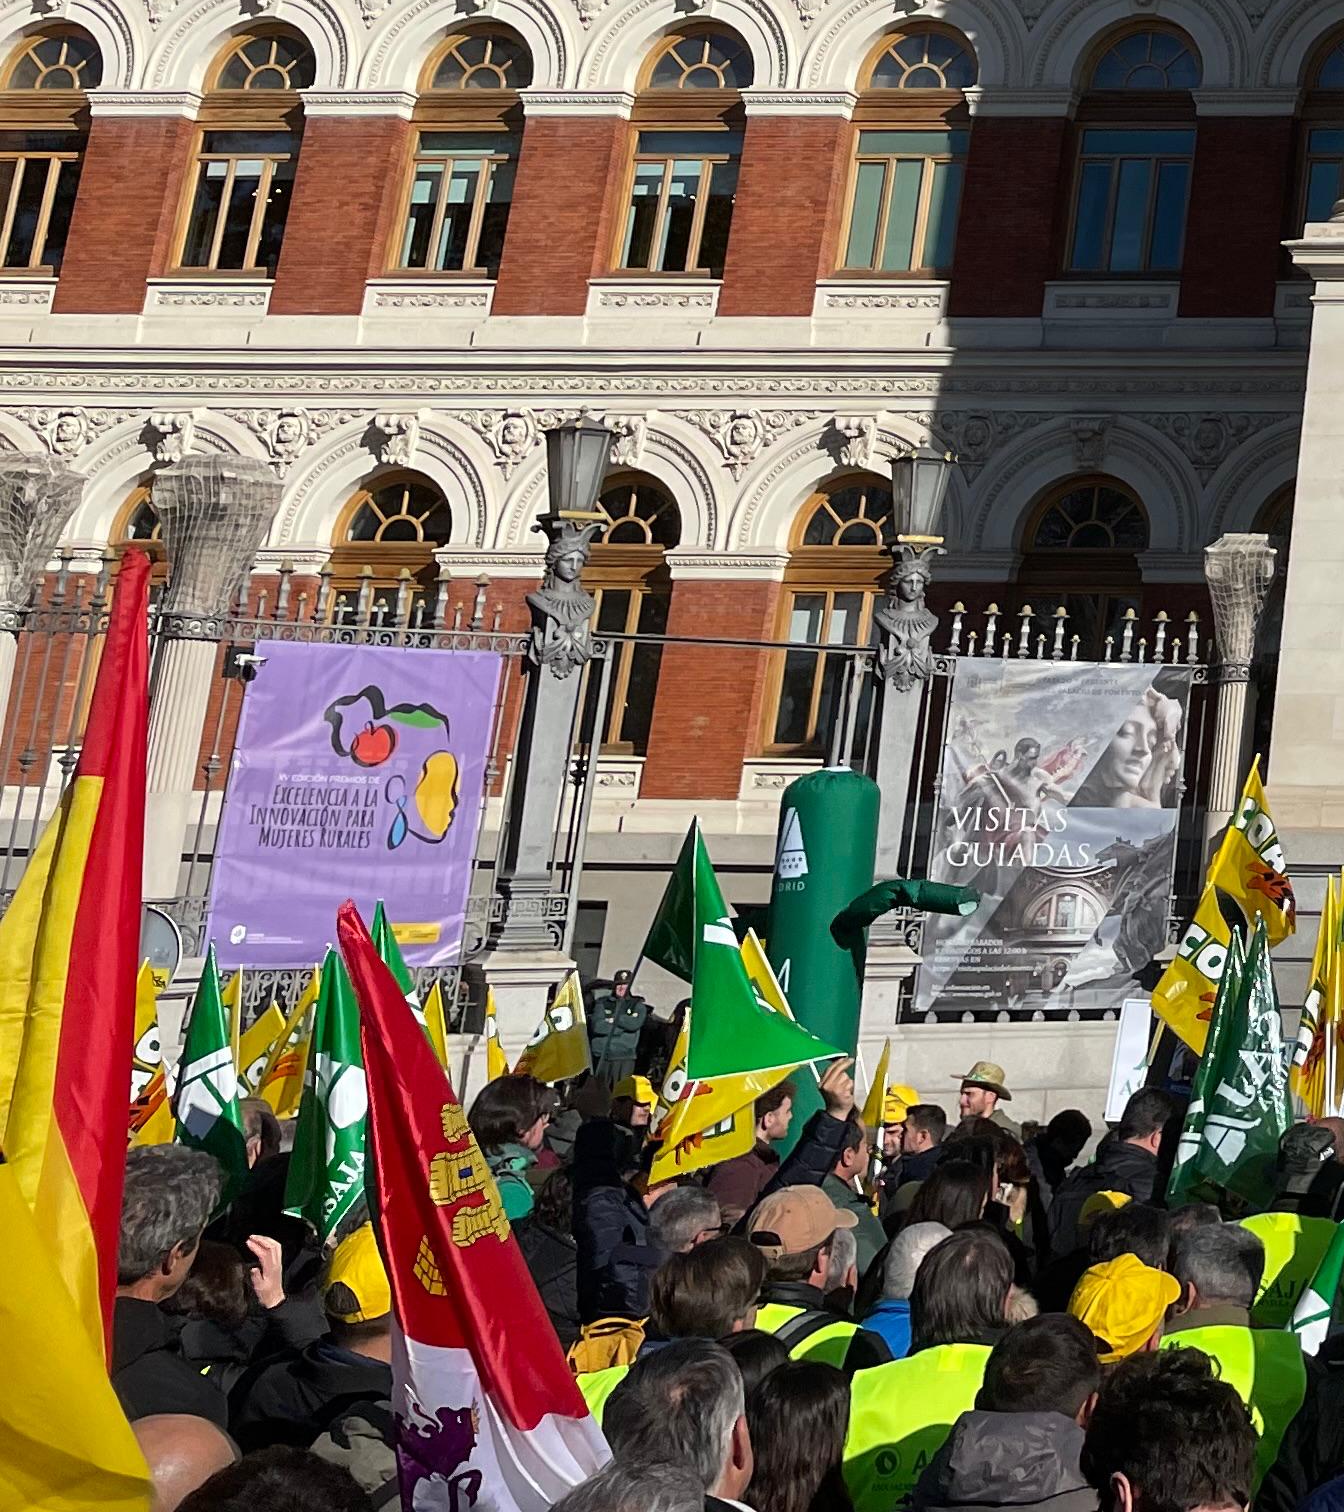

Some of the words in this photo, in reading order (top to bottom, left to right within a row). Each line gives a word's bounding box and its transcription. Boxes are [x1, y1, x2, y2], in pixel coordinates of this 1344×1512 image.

[273, 784, 348, 806] EXCELENCIA
[350, 788, 359, 807] A
[364, 788, 378, 808] LA
[249, 804, 341, 827] INNOVACIÓN
[345, 809, 375, 828] PARA
[952, 806, 1068, 833] VISITAS
[258, 826, 315, 849] MUJERES
[319, 827, 371, 849] RURALES
[946, 841, 1091, 868] GUIADAS
